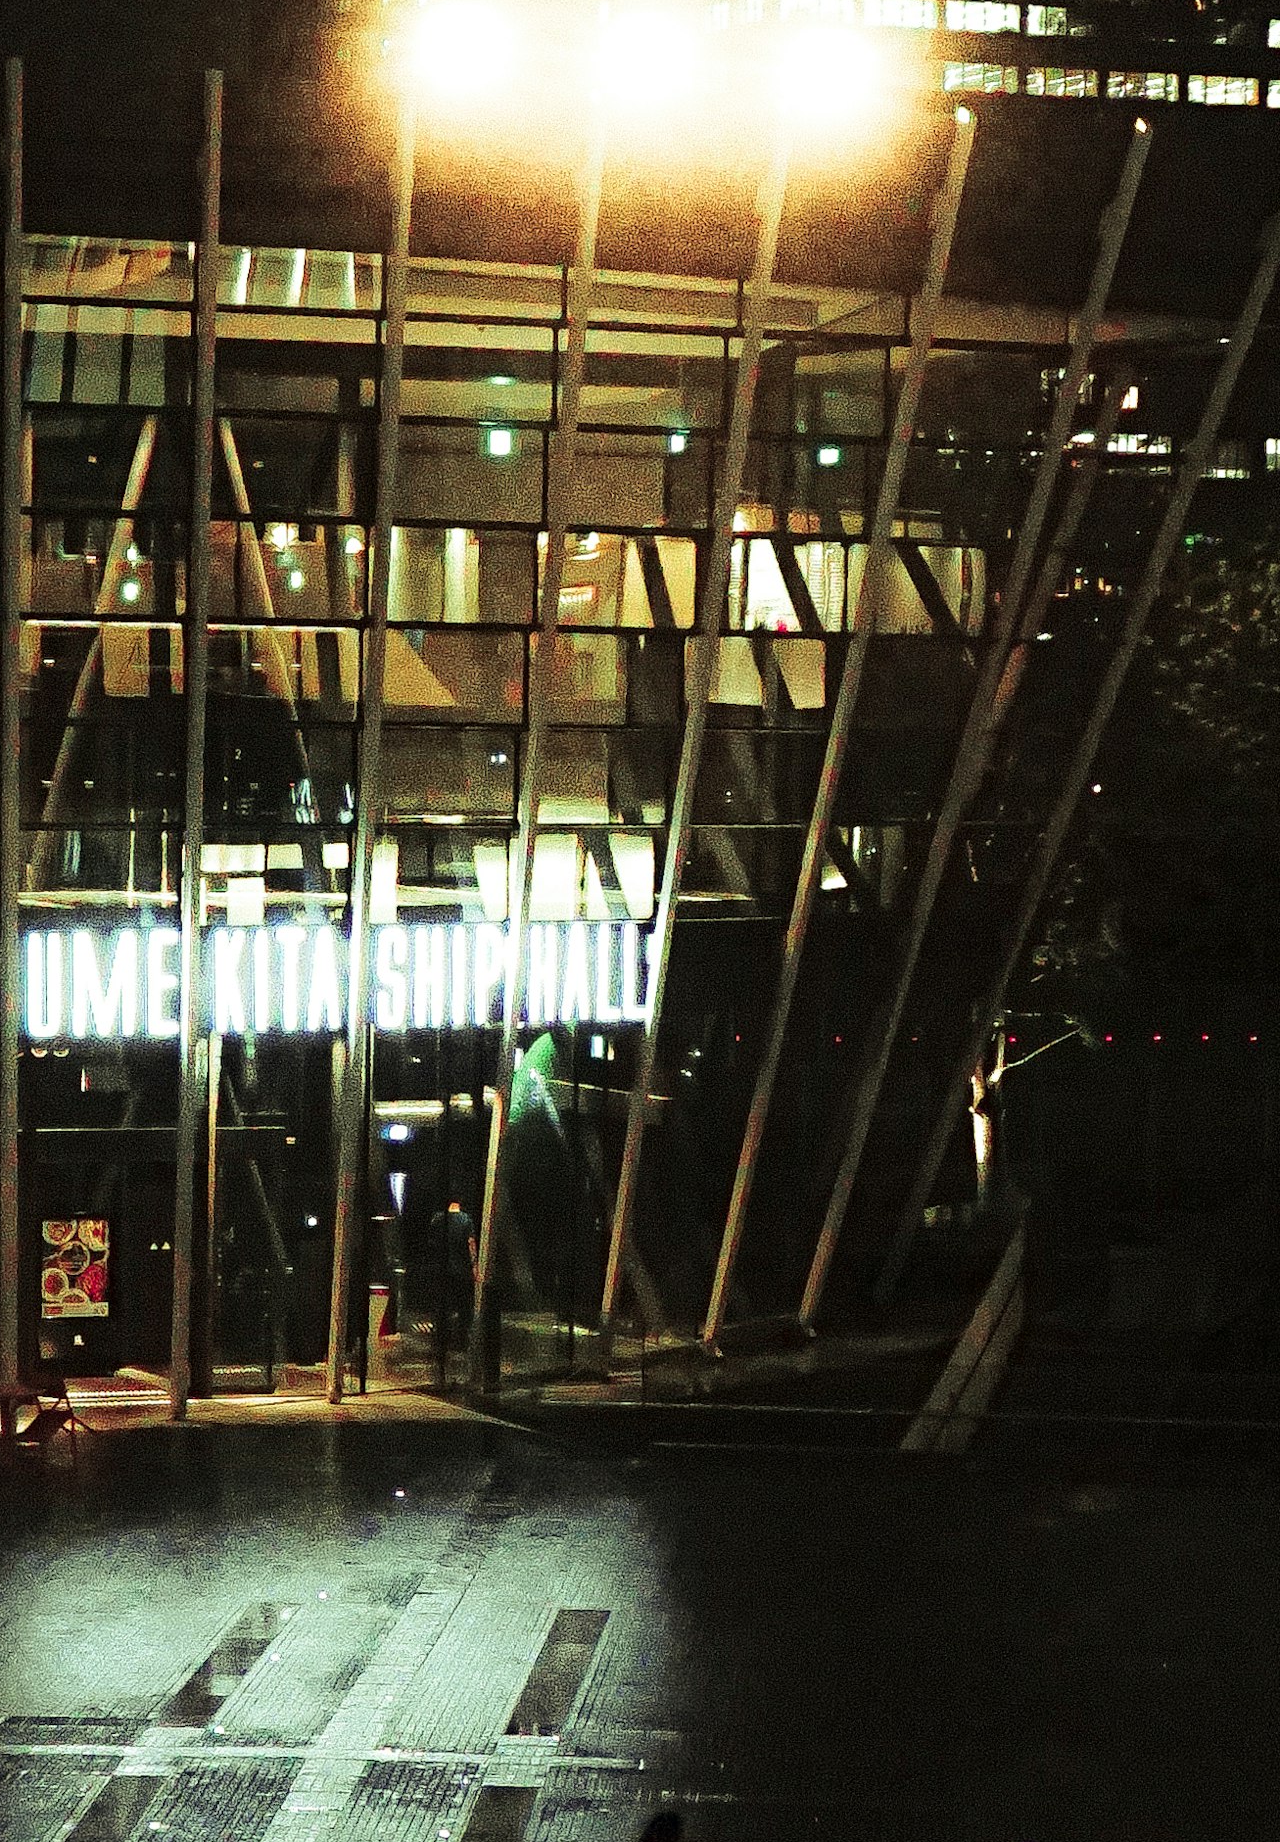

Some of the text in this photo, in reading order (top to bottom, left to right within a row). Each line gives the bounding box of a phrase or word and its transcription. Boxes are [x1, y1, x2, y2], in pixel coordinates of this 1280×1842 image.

[26, 922, 648, 1038] UME KITA SHIP HALL
